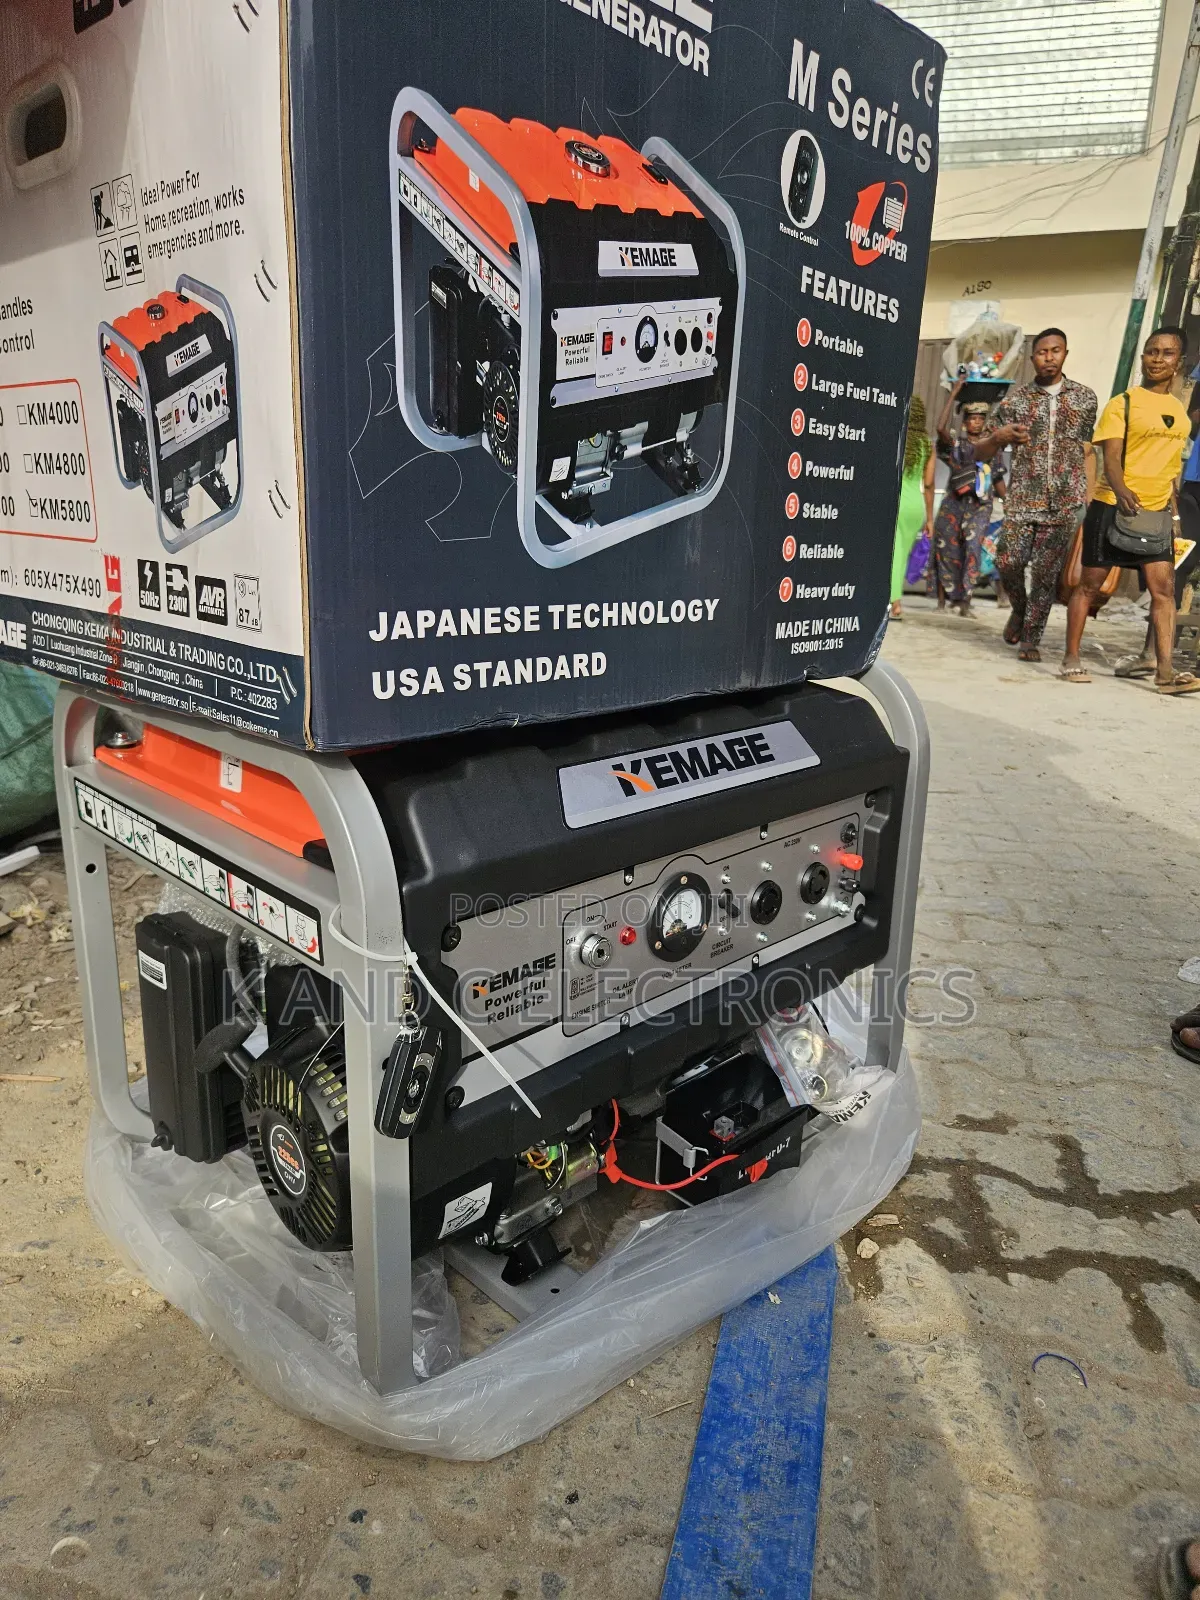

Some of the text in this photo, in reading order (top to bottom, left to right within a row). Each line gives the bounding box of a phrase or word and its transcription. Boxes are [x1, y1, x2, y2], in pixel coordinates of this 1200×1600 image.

[911, 59, 936, 108] CE
[788, 38, 932, 173] M Series
[141, 170, 200, 207] Ideal Power For
[214, 185, 245, 211] works
[148, 219, 245, 259] emergencies and more.
[779, 222, 819, 247] Remote Control
[845, 220, 907, 262] 100% COPPER
[618, 245, 676, 267] KEMAGE
[800, 265, 900, 323] FEATURES
[0, 296, 33, 320] andles
[0, 328, 35, 354] ontrol
[560, 333, 595, 347] KEMAGE
[564, 346, 591, 357] Powerful
[814, 329, 864, 358] Portable
[565, 357, 589, 367] Reliable
[797, 370, 898, 407] 2 Large Fuel Tank
[27, 401, 79, 425] KM4000
[794, 415, 866, 442] 3 Easy Start
[34, 453, 86, 476] KM4800
[805, 460, 854, 480] Powerful
[39, 498, 91, 523] KM5800
[788, 499, 838, 520] 5 Stable
[799, 544, 844, 559] Reliable
[24, 568, 101, 598] 605X475X490
[796, 584, 830, 601] Heavy
[831, 583, 855, 599] duty
[140, 590, 160, 608] 50Hz
[168, 595, 188, 613] 230V
[199, 584, 225, 609] AVR
[198, 604, 225, 617] AUTOMATIC
[238, 607, 250, 624] 87
[368, 598, 720, 642] JAPANESE TECHNOLOGY
[775, 615, 860, 640] MADE IN CHINA
[32, 611, 83, 635] CHONGQING
[85, 623, 110, 641] KEMA
[111, 627, 168, 655] INDUSTRIAL
[169, 640, 177, 657] &
[178, 643, 226, 670] TRADING
[32, 634, 45, 647] ADD
[791, 637, 844, 654] ISO9001:2015
[371, 651, 607, 700] USA STANDARD
[607, 732, 775, 798] KEMAGE
[710, 943, 734, 958] BREAKER
[711, 937, 731, 950] CIRCUIT
[470, 952, 556, 999] KEMAGE
[484, 977, 546, 1011] Powerful
[487, 995, 544, 1026] Reliable
